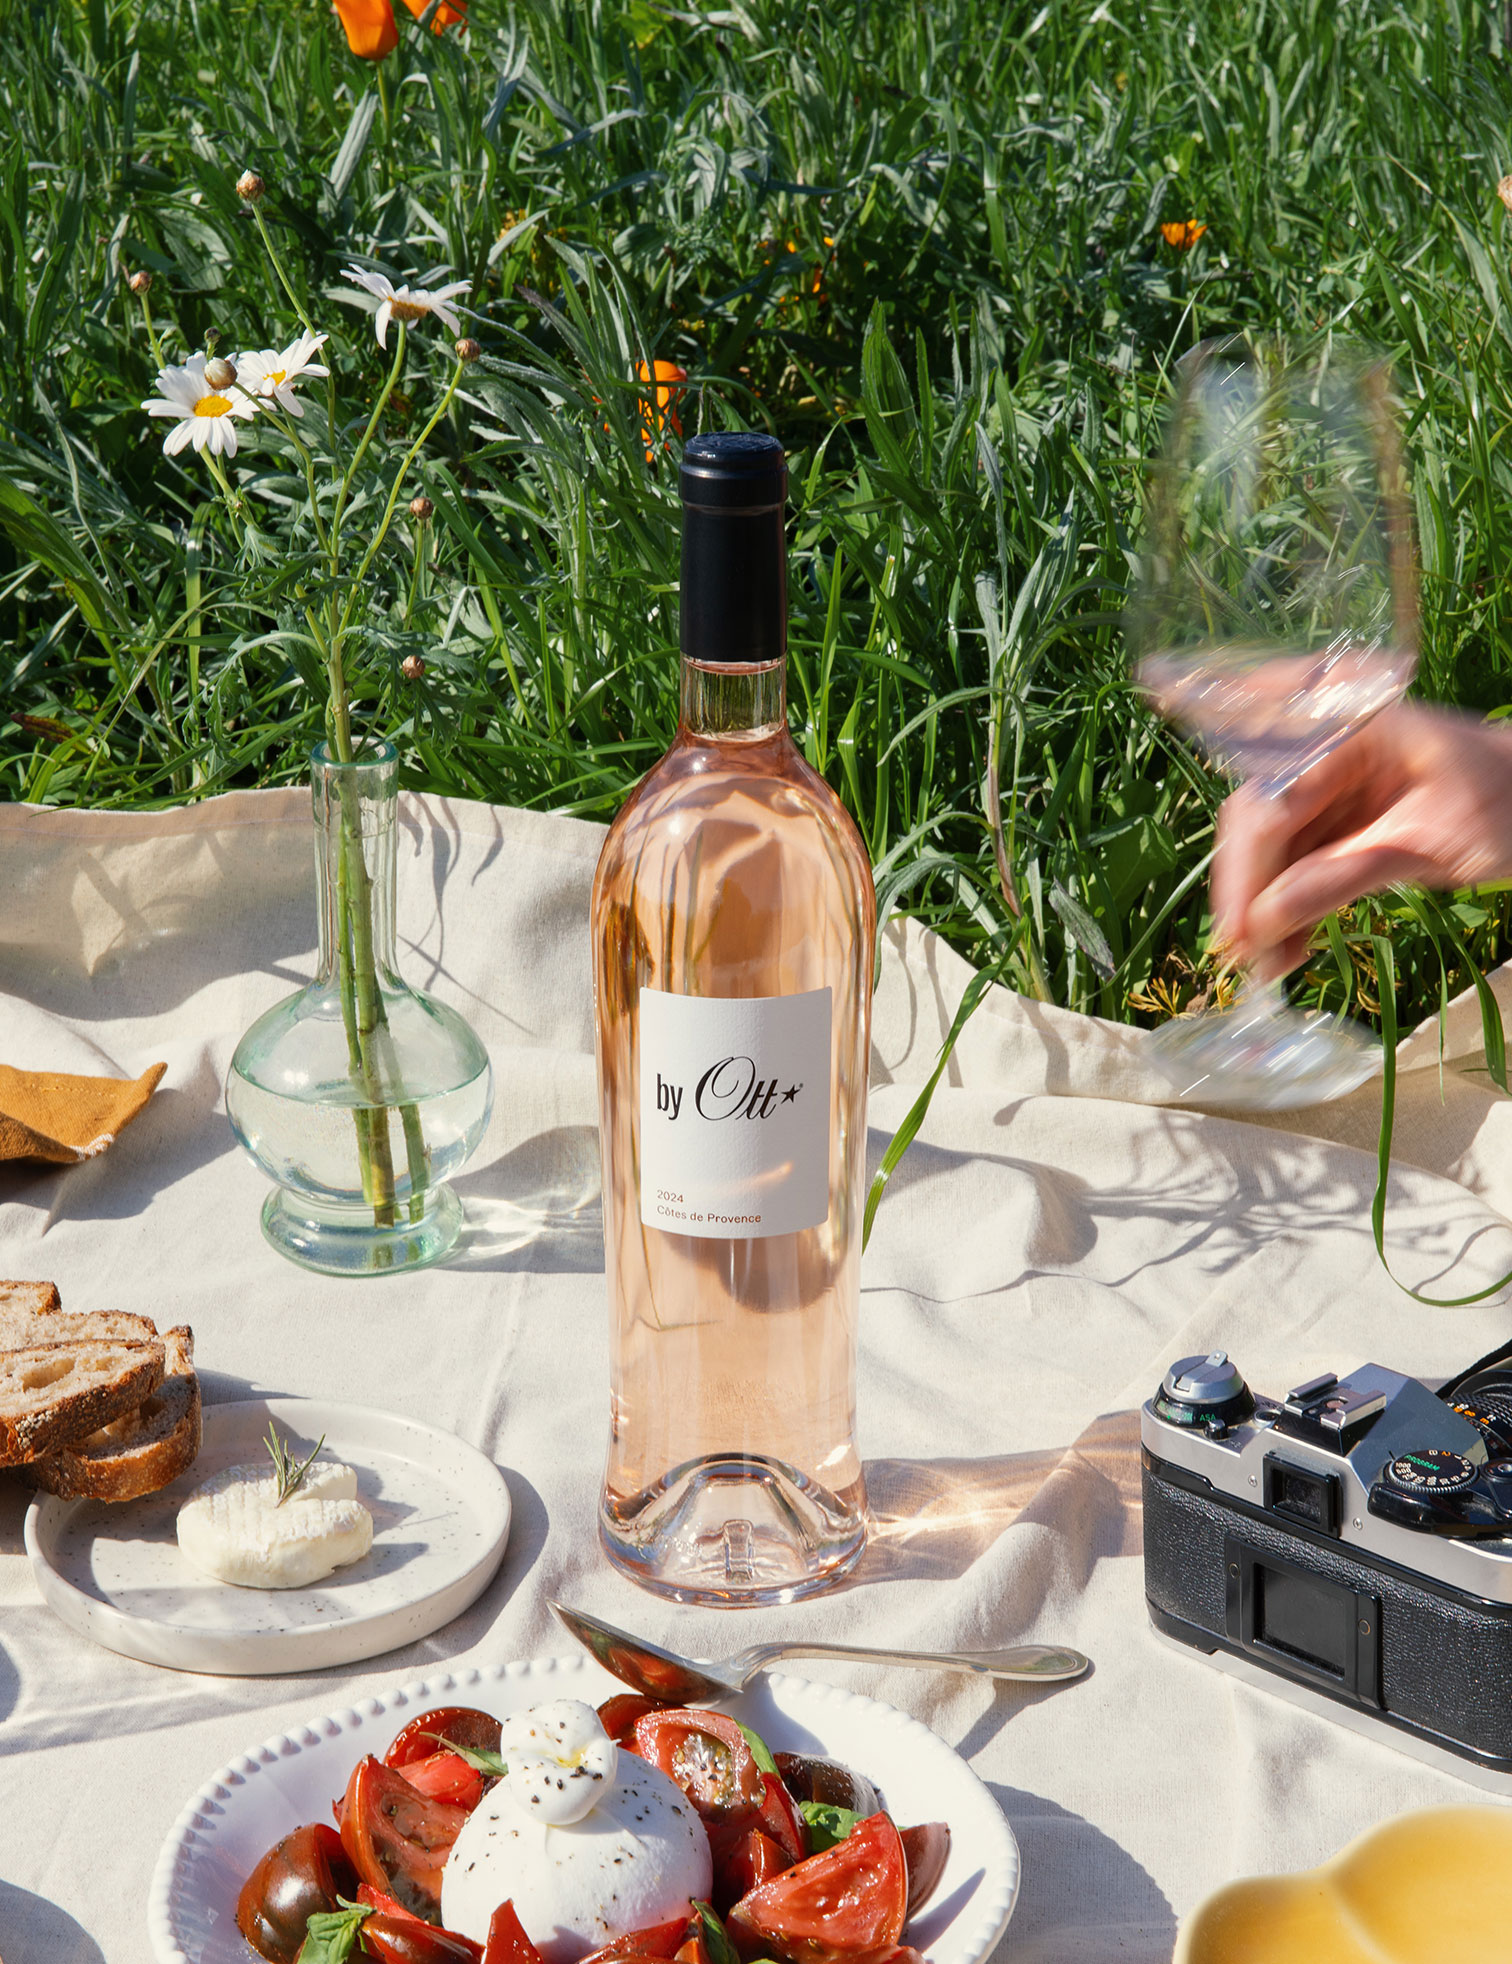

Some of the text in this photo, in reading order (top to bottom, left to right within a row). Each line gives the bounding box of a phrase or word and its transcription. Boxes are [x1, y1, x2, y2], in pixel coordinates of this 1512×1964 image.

[656, 1056, 779, 1121] by Ott
[657, 1189, 684, 1203] 2024
[657, 1205, 762, 1224] Côtes de Provence
[1200, 1413, 1217, 1422] ASA
